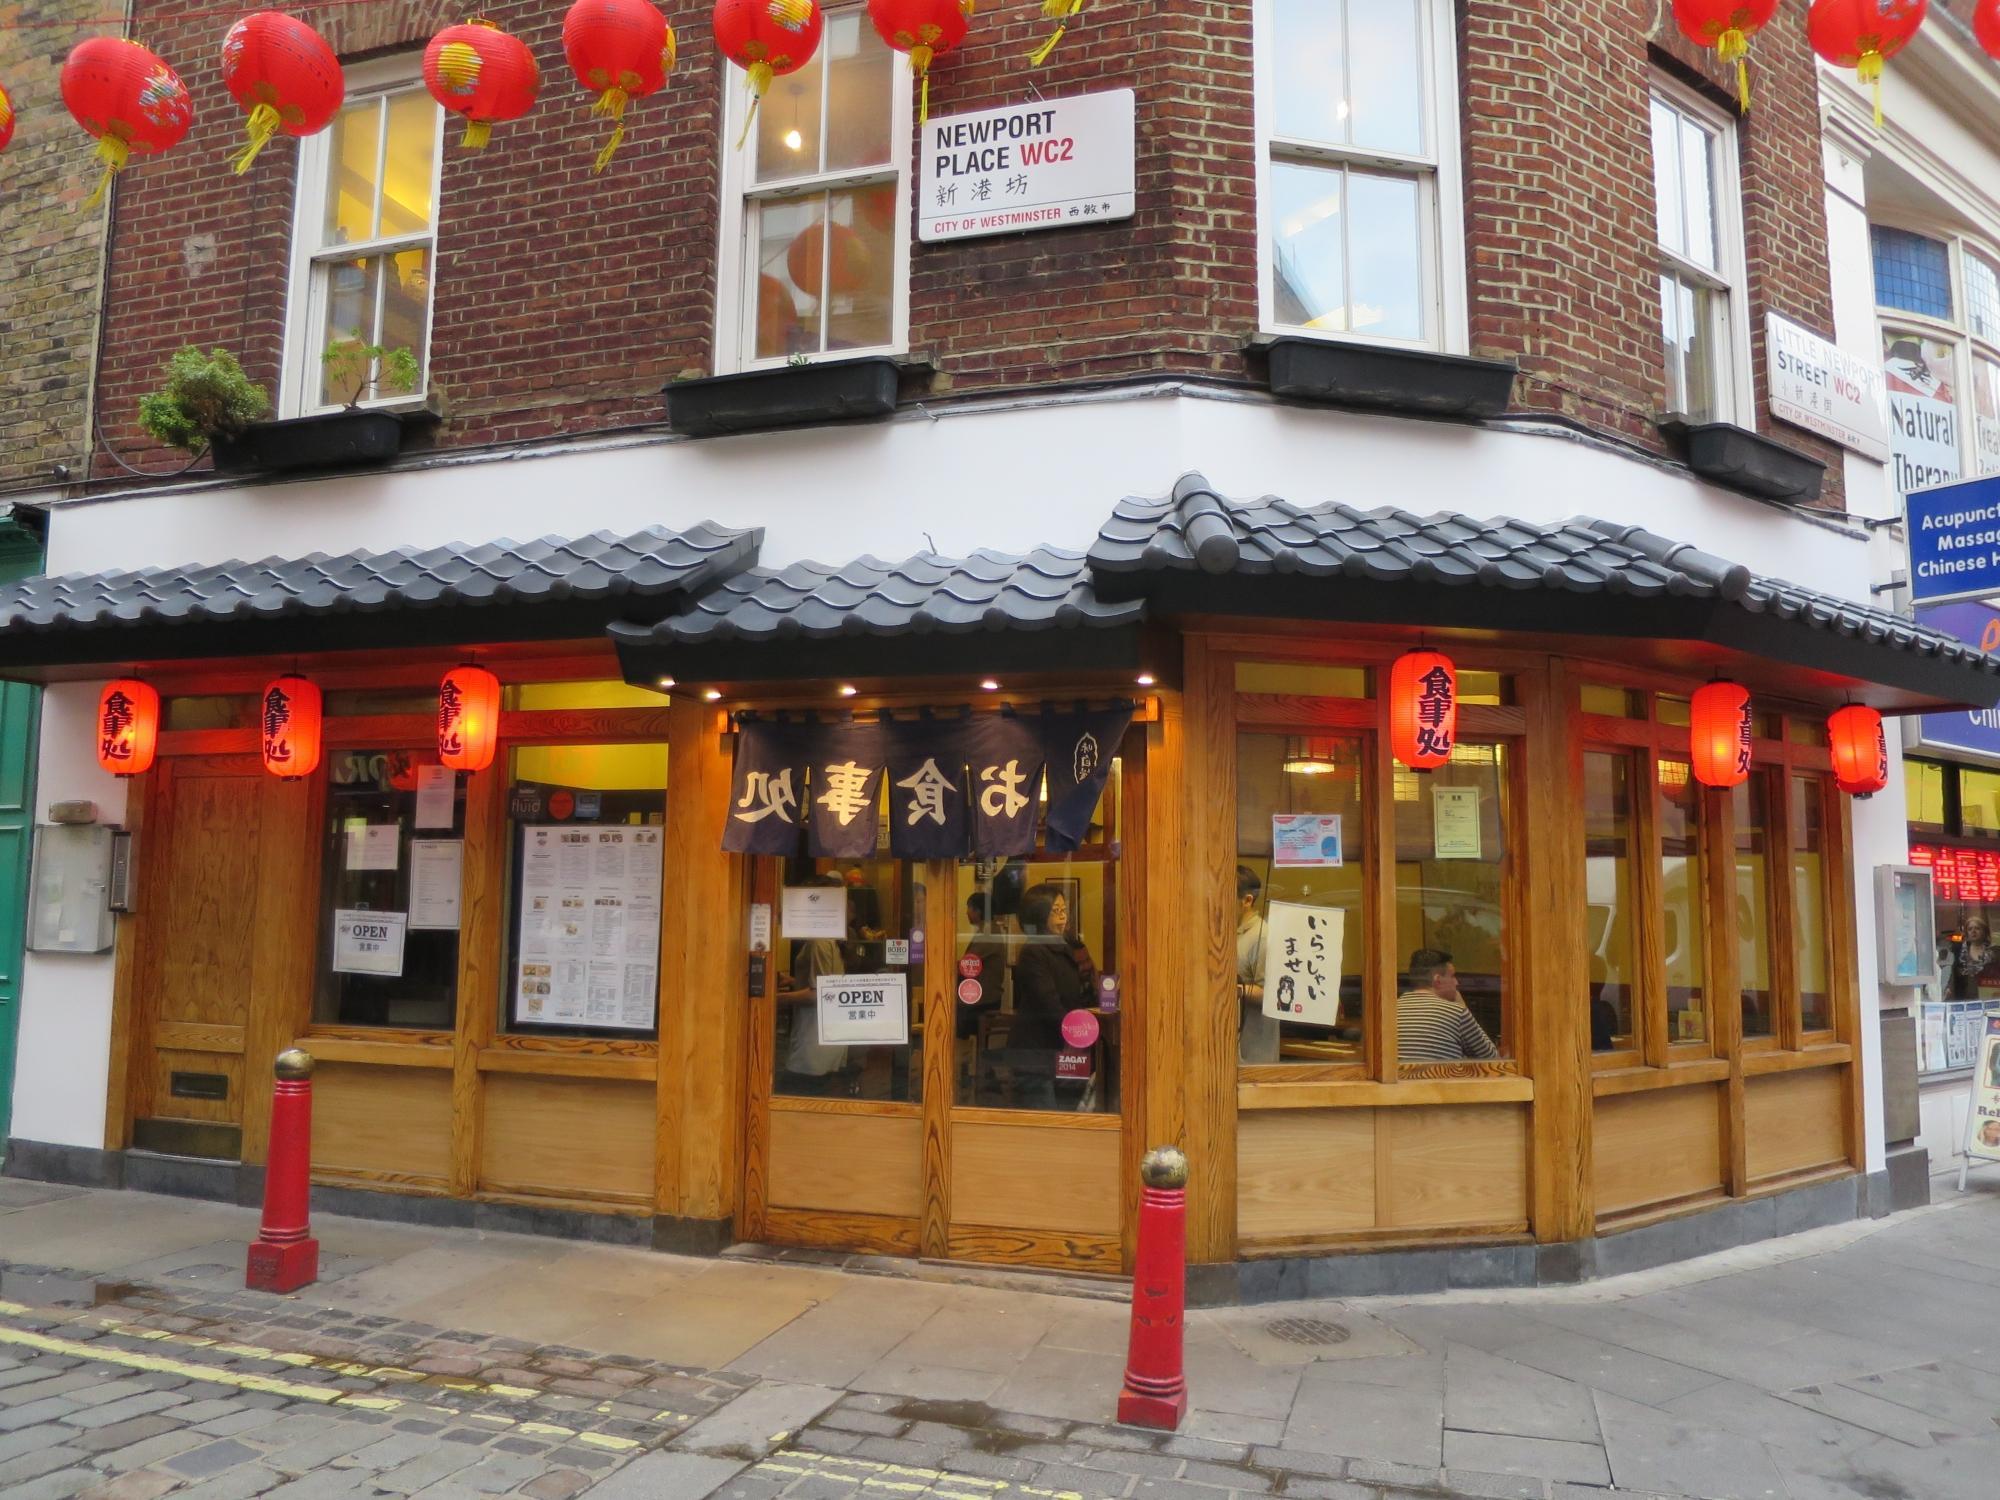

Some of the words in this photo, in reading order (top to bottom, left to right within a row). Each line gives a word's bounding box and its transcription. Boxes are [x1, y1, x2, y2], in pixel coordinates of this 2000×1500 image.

[936, 110, 1056, 150] NEWPORT
[936, 146, 1010, 178] PLACE
[1020, 137, 1074, 166] WC2
[936, 174, 1029, 207] 新港坊
[934, 220, 958, 234] CITY
[962, 218, 977, 230] OF
[981, 208, 1061, 228] WESTMINSTER
[1775, 323, 1817, 360] LITTLE
[1777, 350, 1829, 388] STREET
[1833, 375, 1861, 404] WC2
[1778, 403, 1793, 417] CITY
[1804, 414, 1846, 439] WESTMINSTER
[1891, 398, 1955, 447] Natural
[1918, 555, 1987, 577] Chinese
[101, 691, 135, 760] 食事処
[264, 687, 291, 764] 食事処
[1417, 666, 1452, 756] 食事処
[352, 924, 388, 939] OPEN
[1284, 937, 1304, 974] ませ
[1307, 914, 1327, 1001] いらっしゃい
[838, 990, 884, 1004] OPEN
[848, 1009, 876, 1020] 営業中
[1058, 1055, 1087, 1064] ZAGAT
